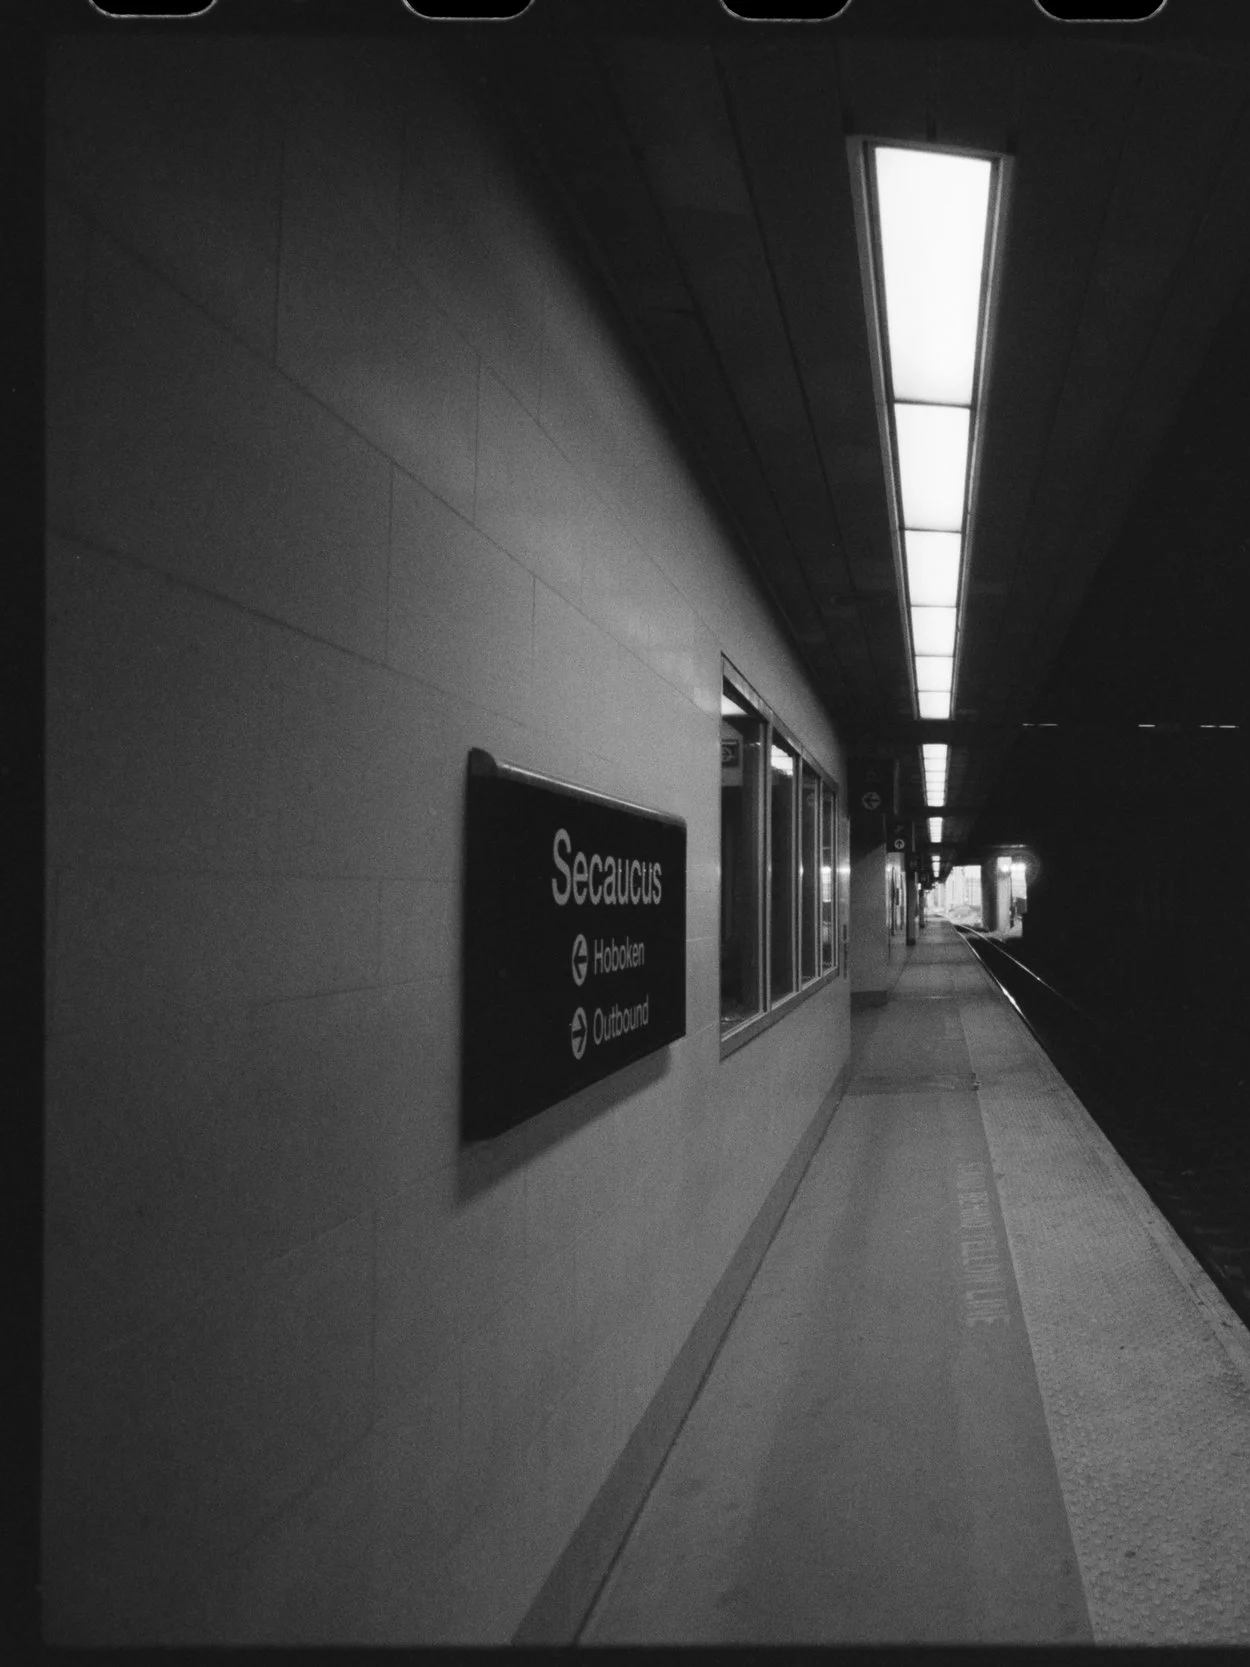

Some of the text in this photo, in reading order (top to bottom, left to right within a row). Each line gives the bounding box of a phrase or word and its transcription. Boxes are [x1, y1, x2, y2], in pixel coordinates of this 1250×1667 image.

[551, 828, 662, 905] Secaucus
[594, 936, 646, 975] Hoboken
[594, 996, 649, 1045] Outbound
